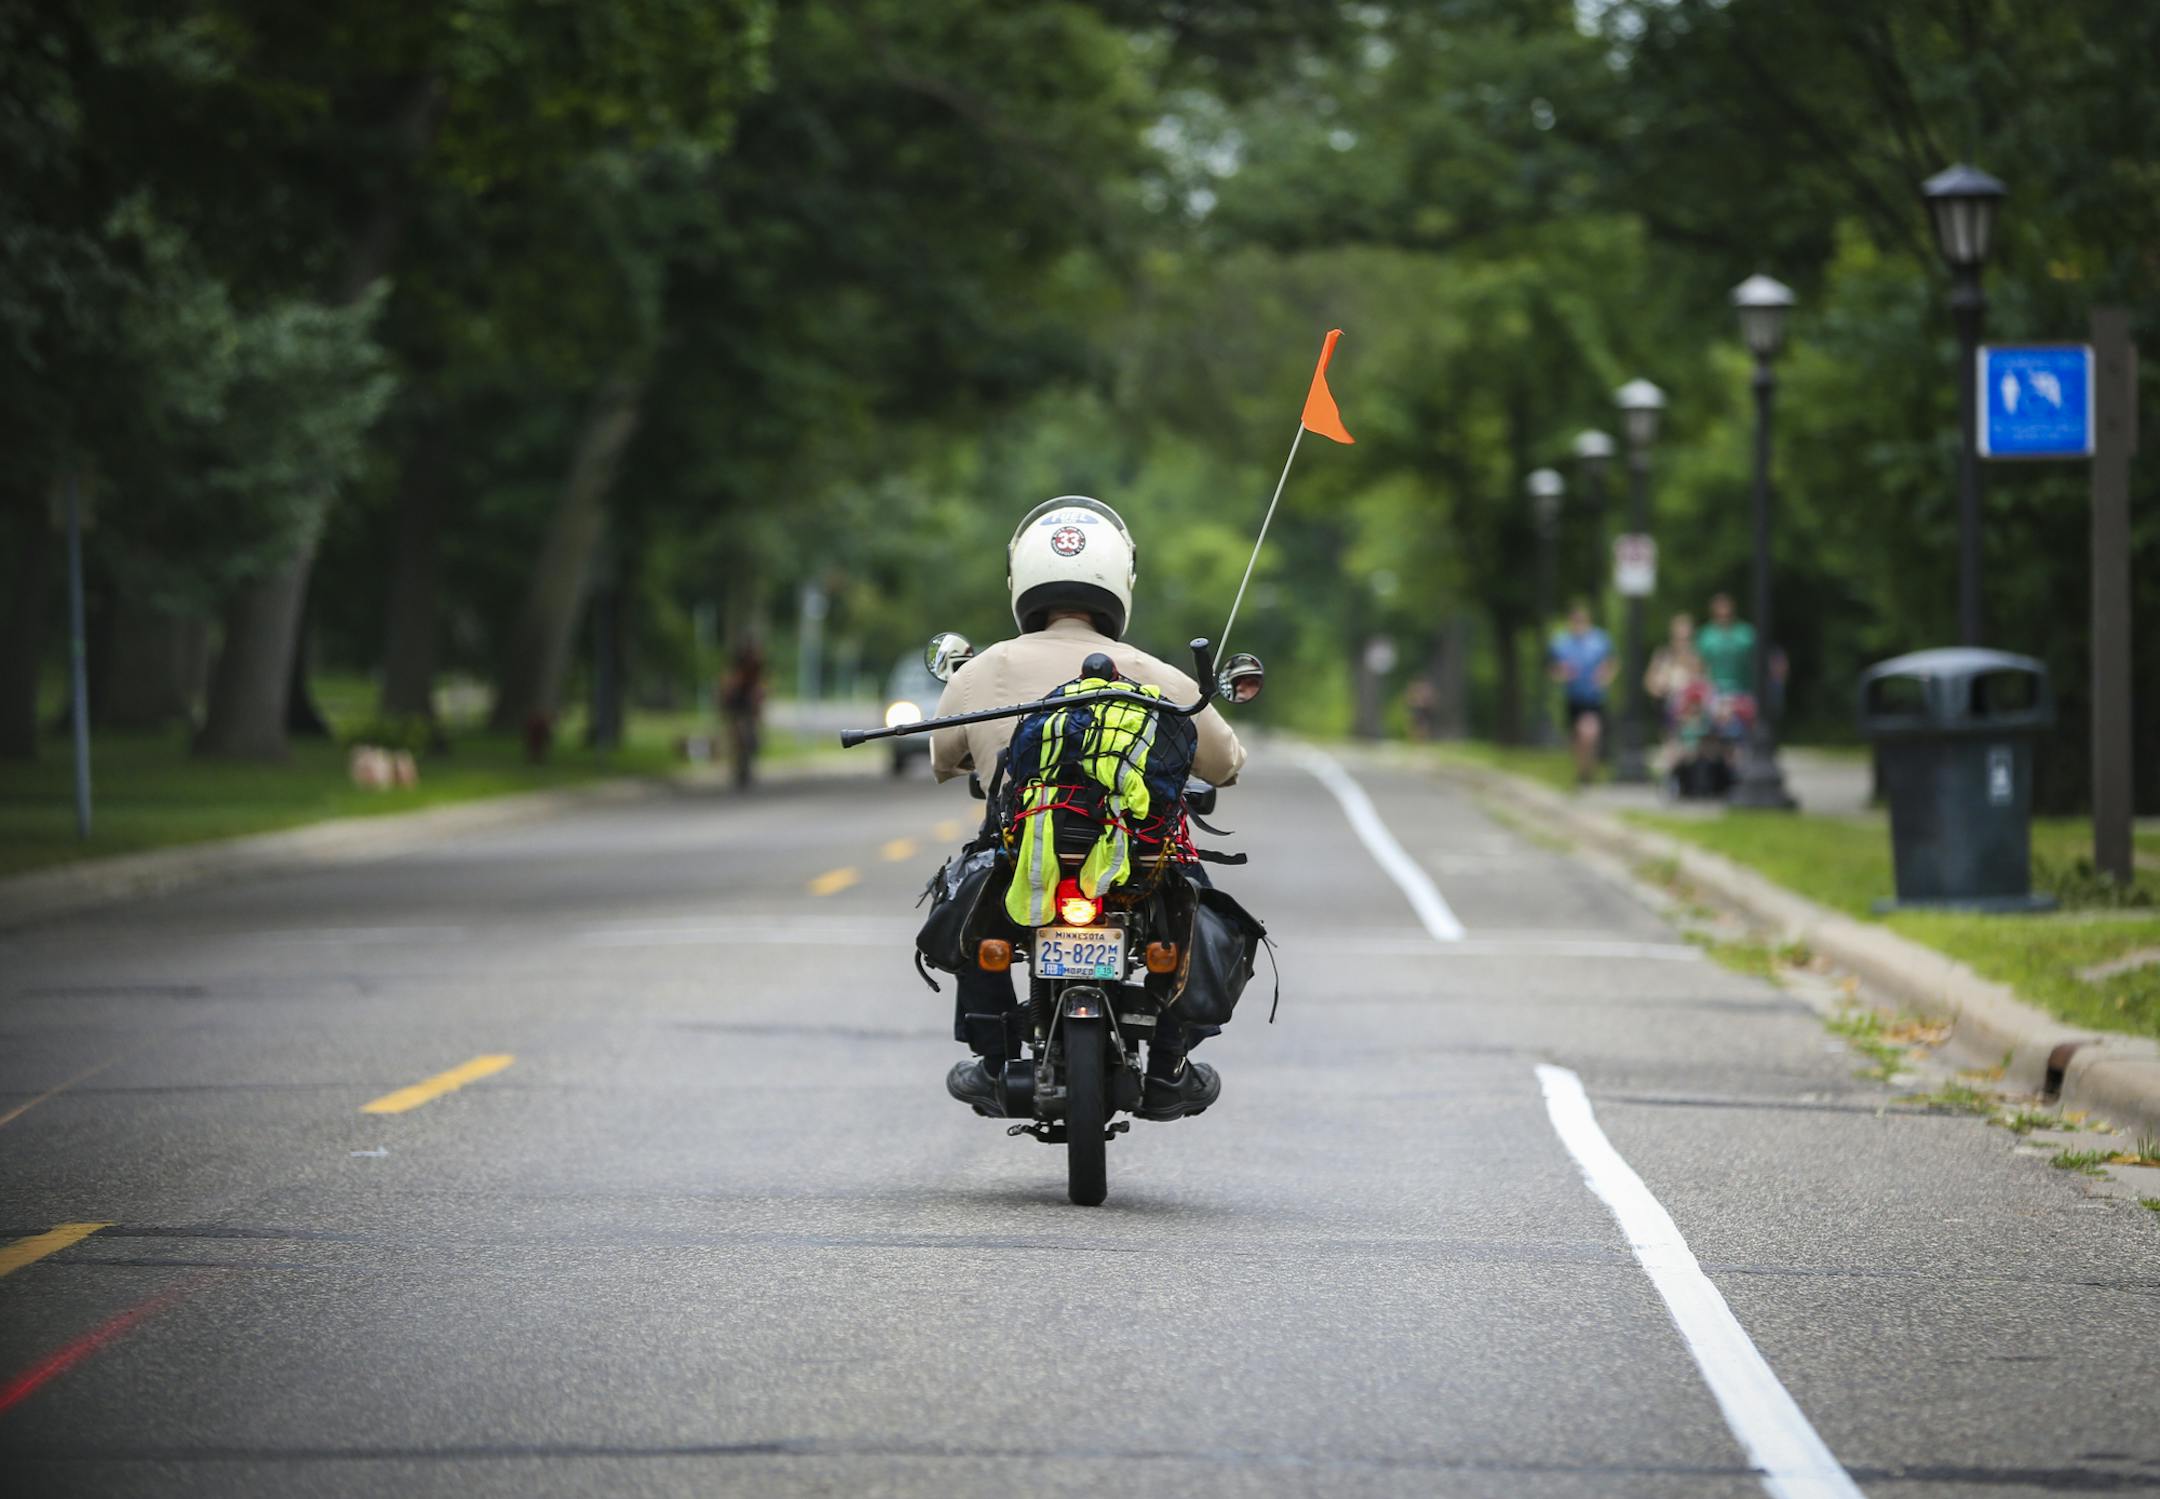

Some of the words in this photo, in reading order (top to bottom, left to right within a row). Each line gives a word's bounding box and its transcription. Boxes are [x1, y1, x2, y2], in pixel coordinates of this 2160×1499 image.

[1057, 532, 1080, 550] 33
[1055, 931, 1105, 940] MINNESOTA
[1041, 941, 1106, 965] 25-822
